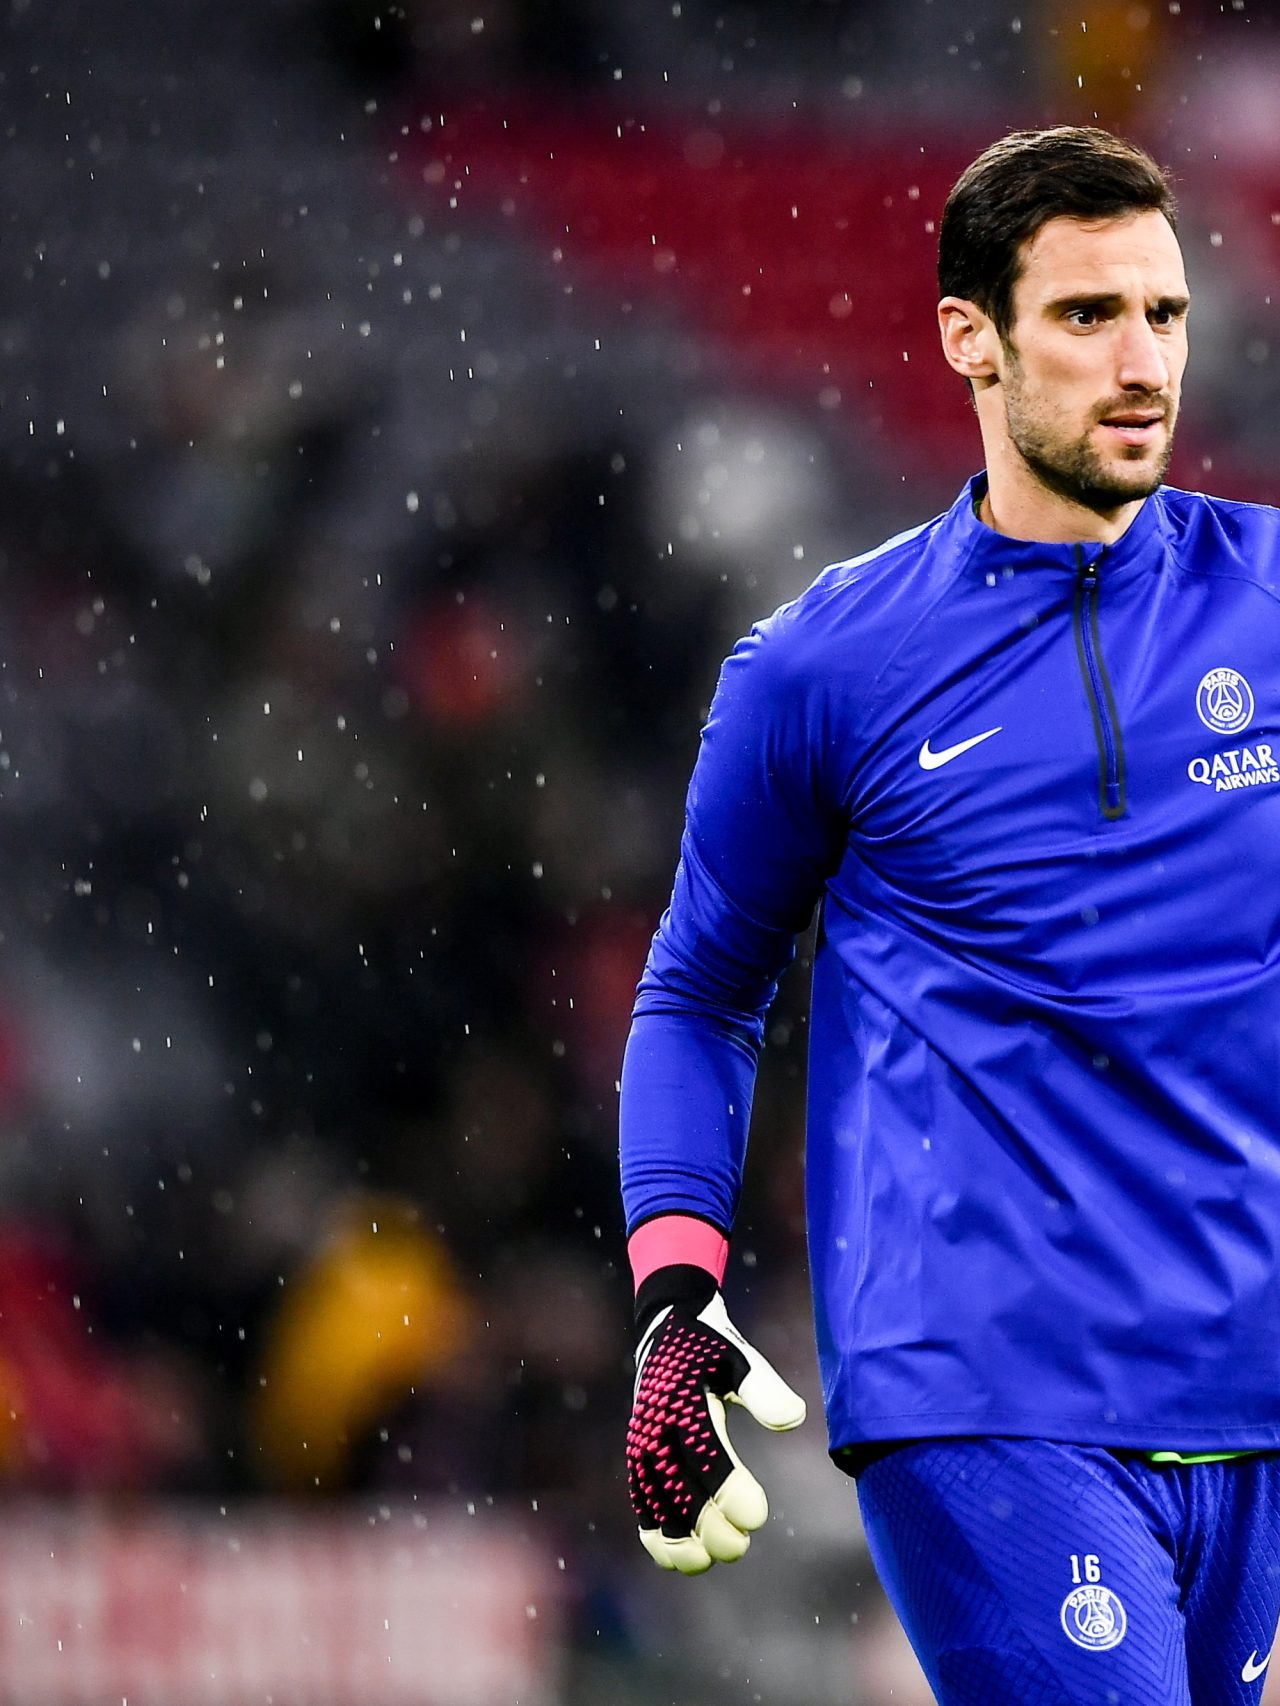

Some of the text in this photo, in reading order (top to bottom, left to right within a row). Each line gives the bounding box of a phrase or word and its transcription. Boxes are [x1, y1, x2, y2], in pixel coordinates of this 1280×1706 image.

[1203, 671, 1240, 691] PARIS
[1187, 744, 1278, 785] QATAR
[1216, 767, 1280, 793] AIRWAYS
[1070, 1554, 1101, 1584] 16
[1068, 1589, 1111, 1609] PARIS
